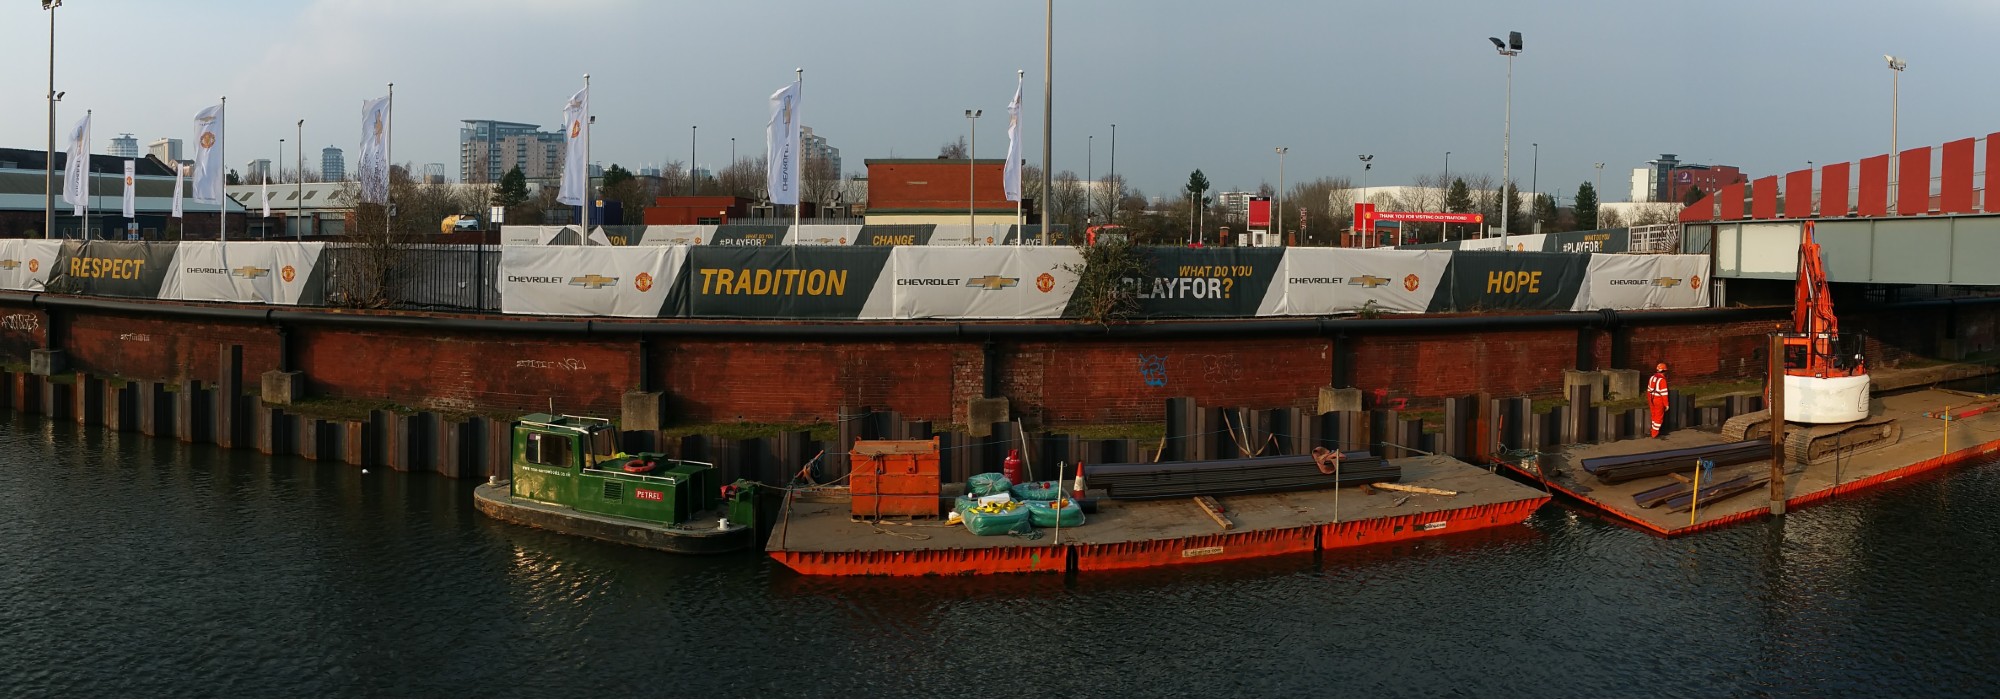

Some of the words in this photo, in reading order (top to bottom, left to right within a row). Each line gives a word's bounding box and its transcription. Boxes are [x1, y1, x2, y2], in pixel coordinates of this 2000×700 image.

[872, 234, 916, 246] CHANGE
[1562, 240, 1604, 253] #PLAYFOR?
[70, 257, 145, 280] RESPECT
[186, 267, 228, 275] CHEVROLET
[1179, 265, 1212, 277] WHAT
[1213, 265, 1228, 277] DO
[1231, 265, 1253, 277] YOU
[507, 275, 563, 284] CHEVROLET
[700, 268, 848, 296] TRADITION
[896, 278, 961, 286] CHEVROLET
[1289, 277, 1343, 285] CHEVROLET
[1486, 270, 1543, 294] HOPE
[636, 490, 661, 500] PETREL
